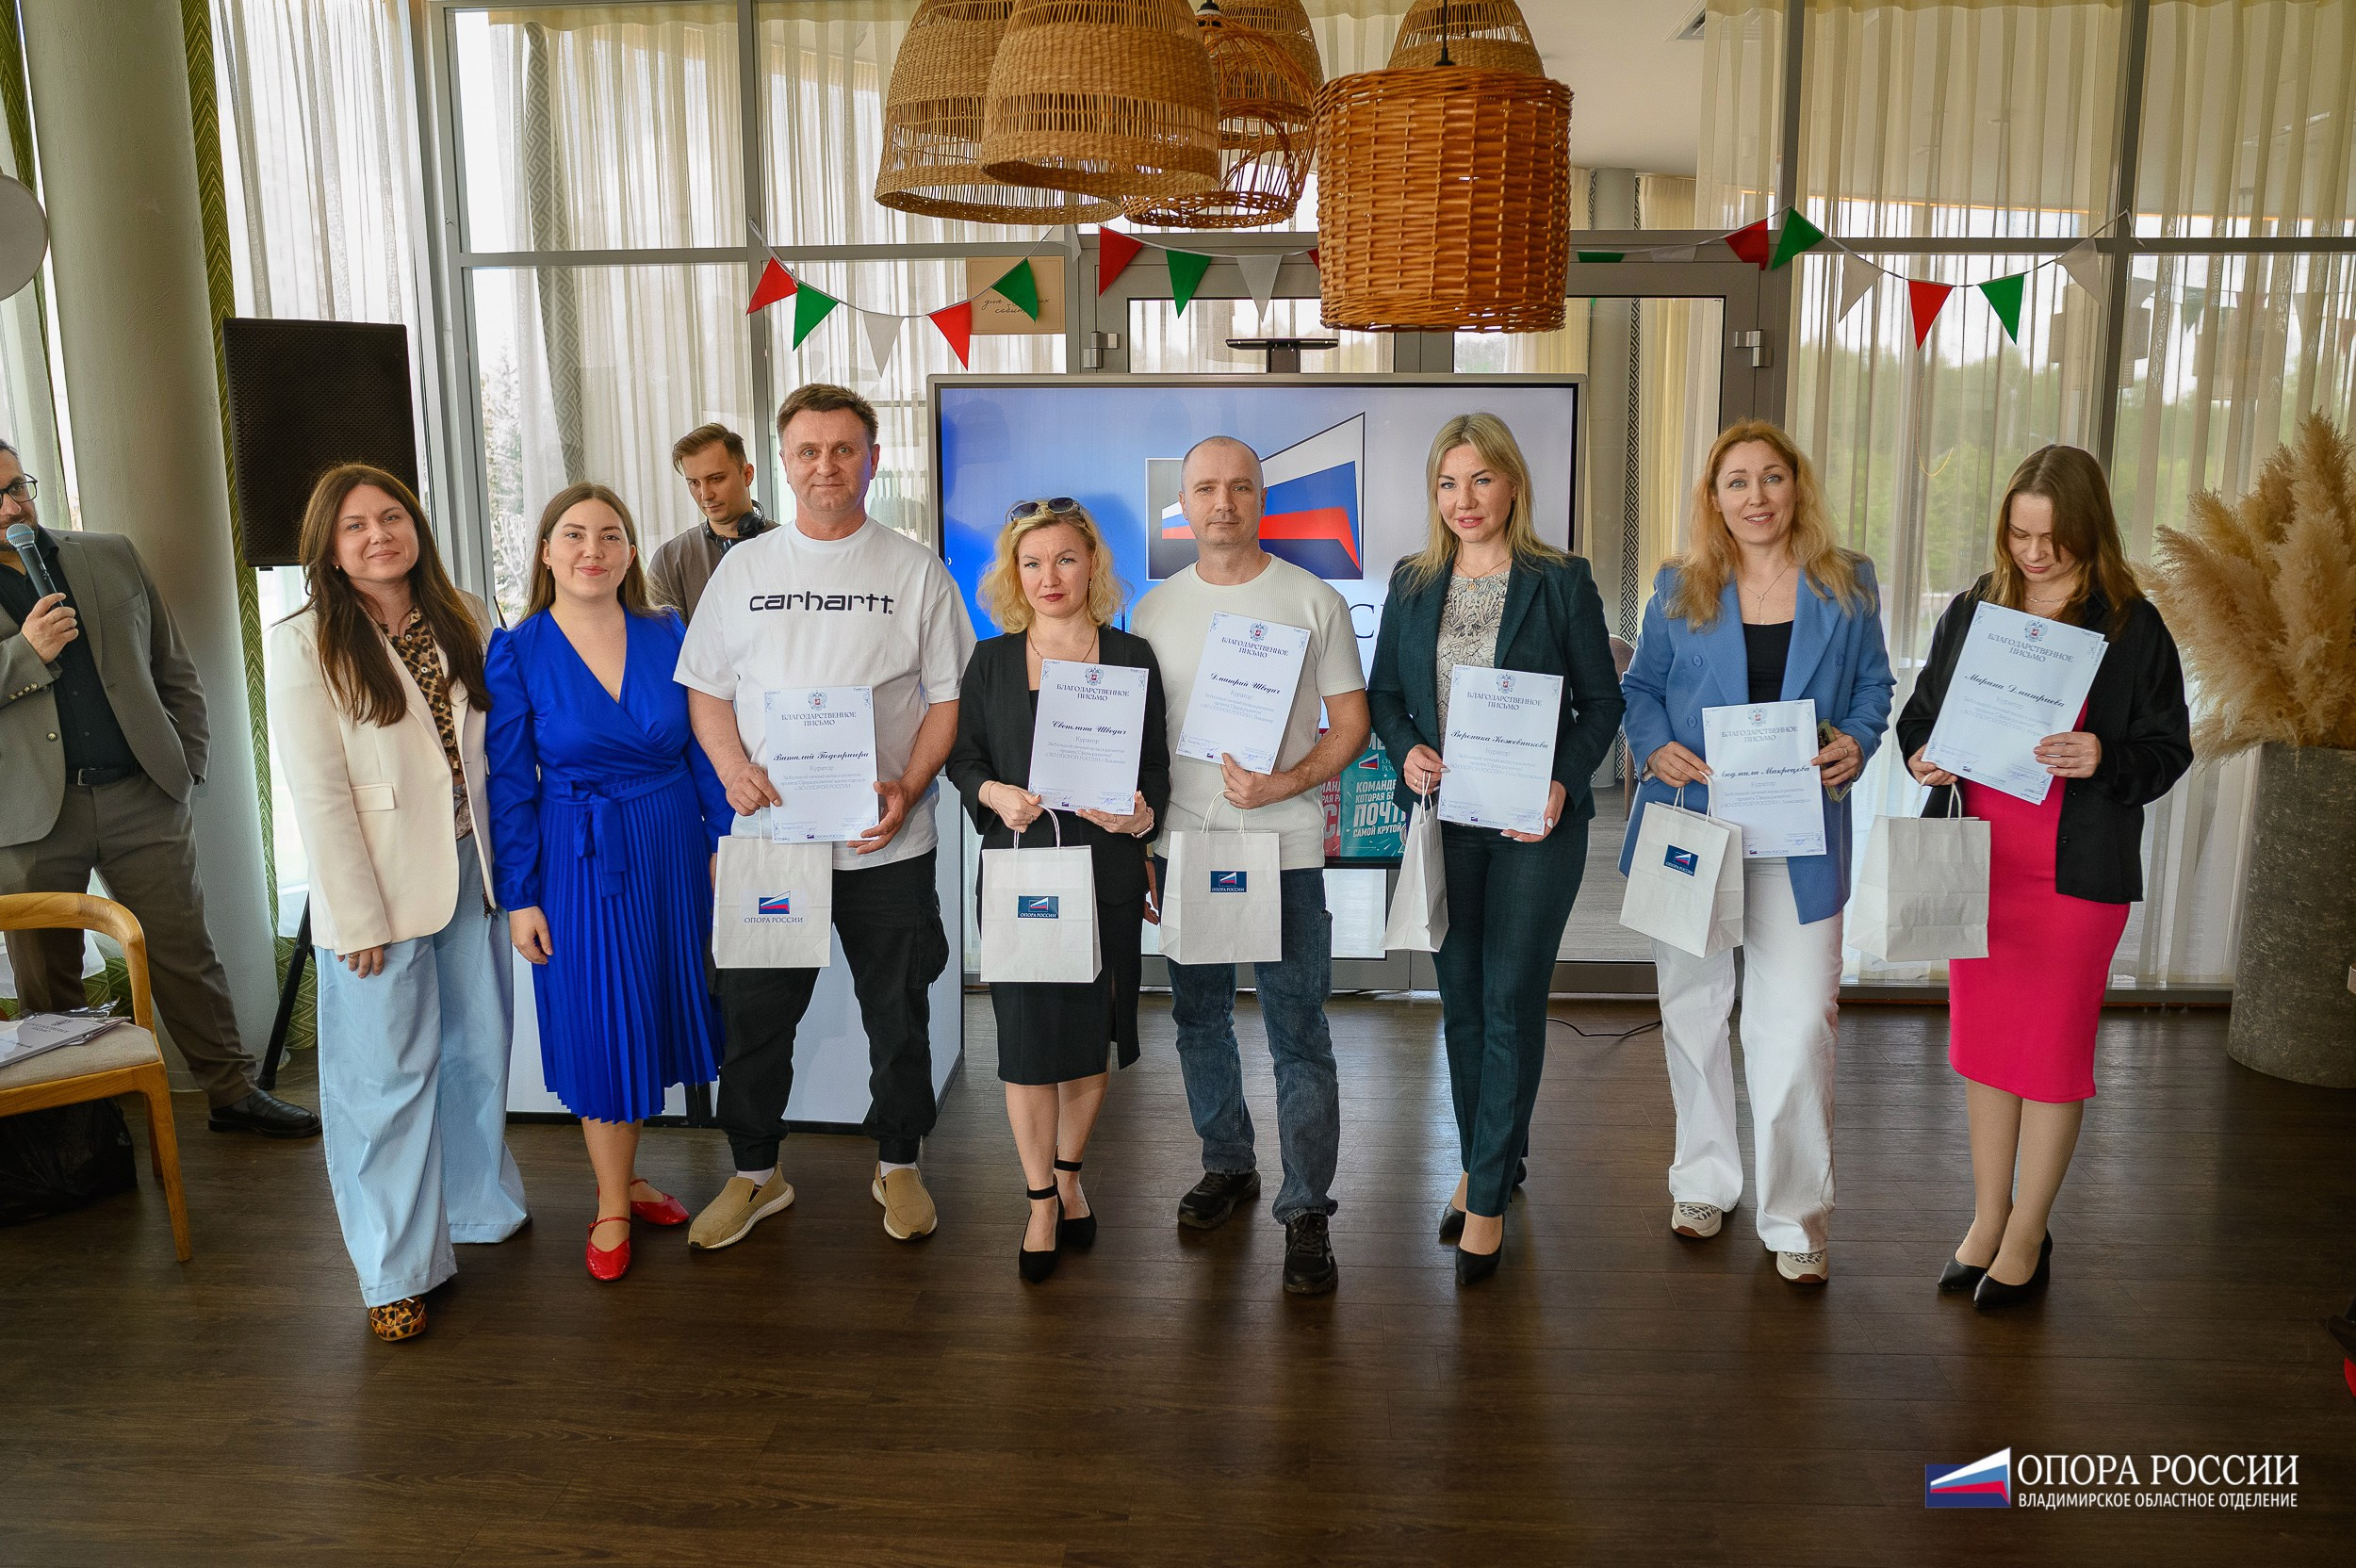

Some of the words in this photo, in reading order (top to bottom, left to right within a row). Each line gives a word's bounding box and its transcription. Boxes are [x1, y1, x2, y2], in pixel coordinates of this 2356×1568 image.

[1221, 636, 1289, 656] БЛАГОДАРСТВЕННОЕ
[1988, 632, 2074, 662] БЛАГОДАРСТВЕННОЕ
[1238, 647, 1268, 658] ПИСЬМО
[2009, 647, 2046, 662] ПИСЬМО
[1210, 672, 1249, 687] Дмитрий
[1056, 683, 1130, 697] БЛАГОДАРСТВЕННОЕ
[1230, 690, 1253, 700] Куратор
[1964, 673, 2004, 690] Марина
[2008, 684, 2066, 708] Дмитриева
[1077, 693, 1108, 701] ПИСЬМО
[1466, 692, 1543, 707] БЛАГОДАРСТВЕННОЕ
[1488, 701, 1519, 710] ПИСЬМО
[781, 711, 857, 721] БЛАГОДАРСТВЕННОЕ
[1052, 720, 1092, 732] Светлана
[1722, 726, 1798, 738] БЛАГОДАРСТВЕННОЕ
[1075, 736, 1100, 744] Куратор
[1451, 730, 1491, 742] Вероника
[1492, 736, 1548, 749] Кожевникова
[773, 753, 814, 761] Виталий
[1485, 747, 1510, 757] Куратор
[810, 764, 835, 773] Куратор
[1355, 792, 1384, 804] КОТОРАЯ
[1353, 825, 1376, 838] САМОЙ
